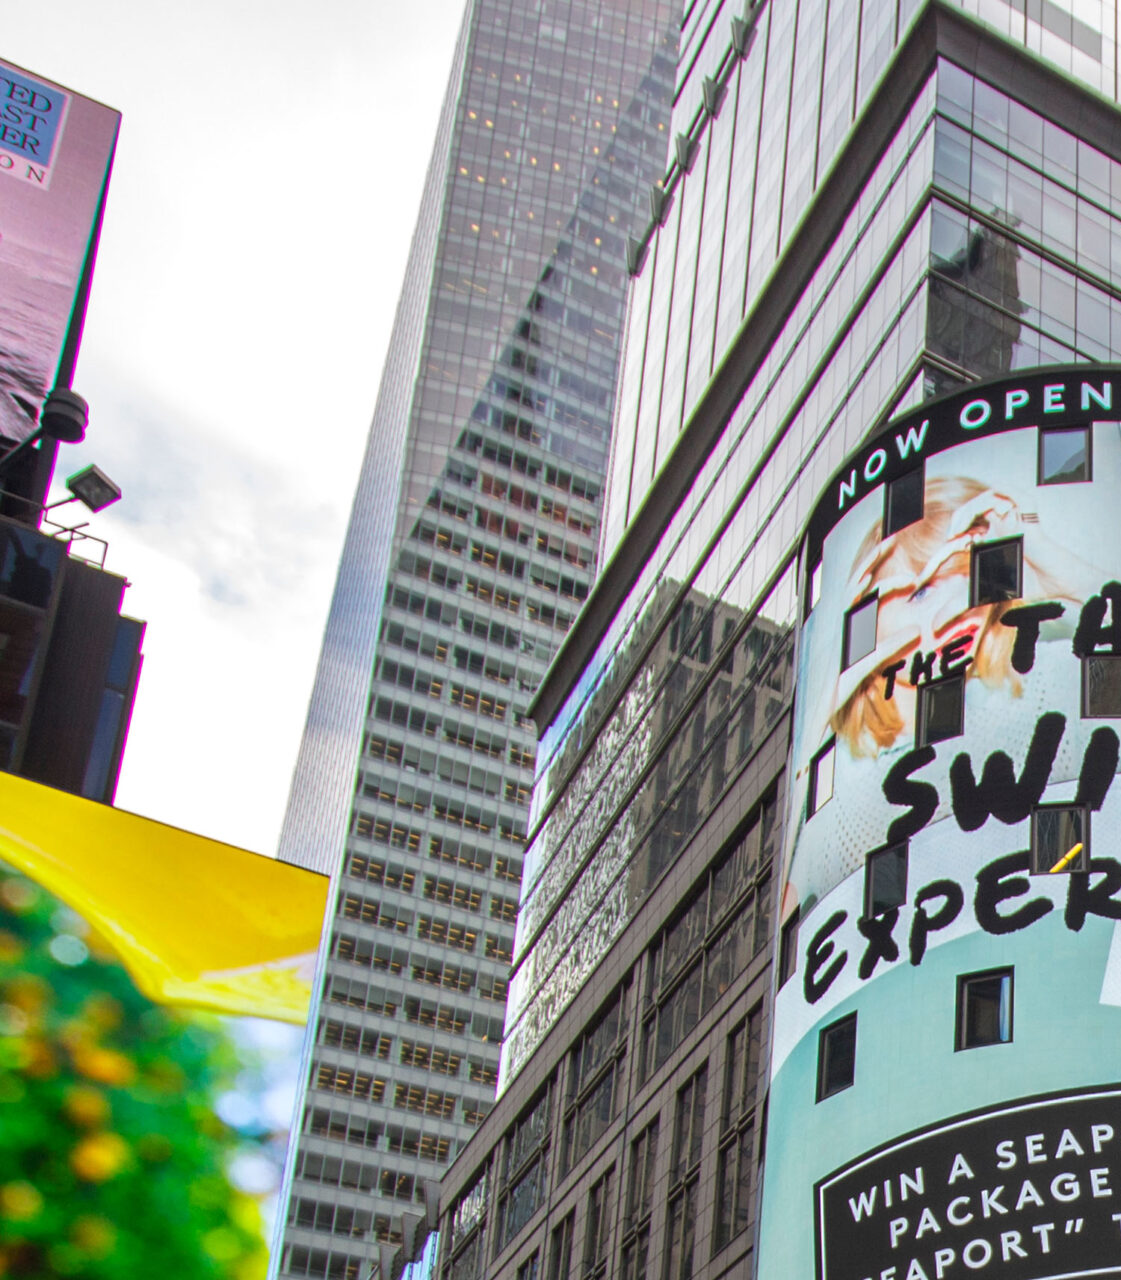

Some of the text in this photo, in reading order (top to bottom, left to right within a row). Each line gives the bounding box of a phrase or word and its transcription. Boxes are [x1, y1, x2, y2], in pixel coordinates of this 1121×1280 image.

[0, 103, 48, 133] ST
[0, 123, 40, 156] ER
[838, 420, 929, 508] NOW
[959, 381, 1113, 429] OPEN
[882, 635, 974, 701] THE
[848, 1166, 926, 1223] WIN
[948, 1154, 975, 1184] A
